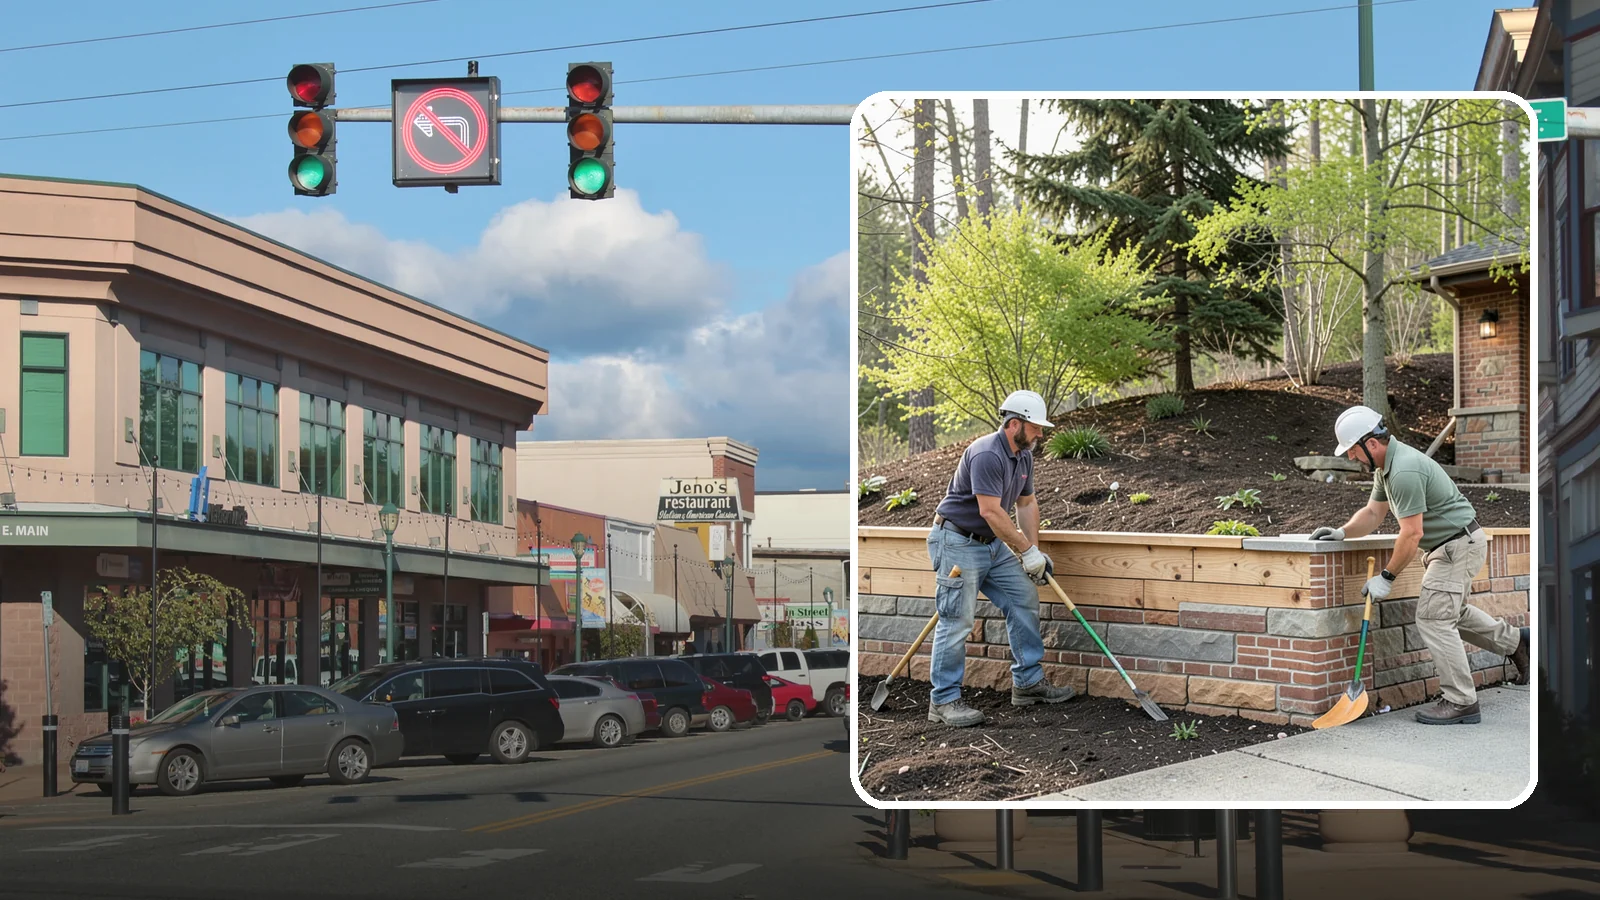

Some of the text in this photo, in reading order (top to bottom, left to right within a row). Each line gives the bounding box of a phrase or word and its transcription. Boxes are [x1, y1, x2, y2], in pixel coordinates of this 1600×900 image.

[670, 480, 727, 494] Jeno's
[665, 497, 731, 509] restaurant
[659, 510, 681, 519] Italian
[686, 509, 714, 519] American
[715, 509, 737, 519] Cuisine
[2, 525, 49, 536] E. MAIN
[797, 607, 829, 617] Street
